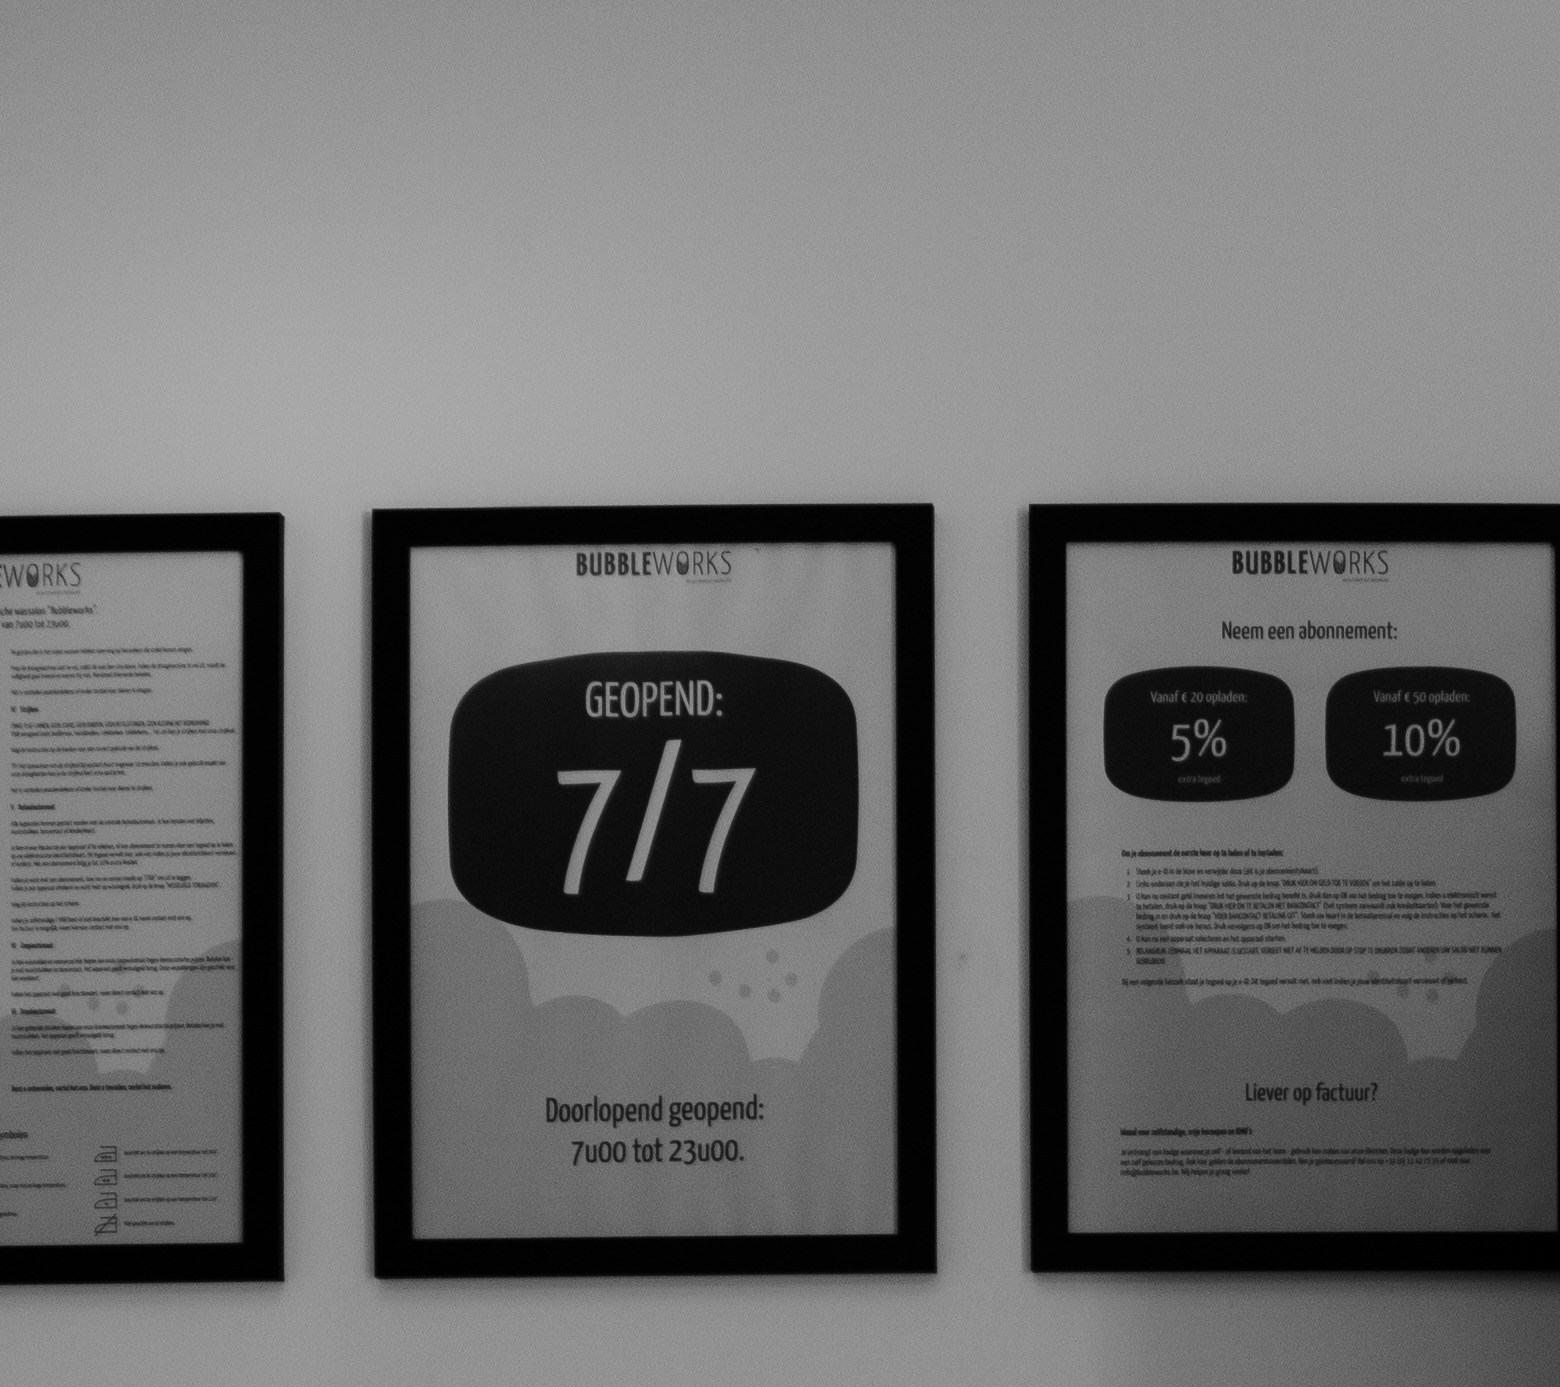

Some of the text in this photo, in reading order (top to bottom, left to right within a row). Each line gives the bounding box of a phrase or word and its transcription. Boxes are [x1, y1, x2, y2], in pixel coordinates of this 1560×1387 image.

[575, 550, 732, 577] BUBBLEWORKS
[1232, 550, 1389, 575] BUBBLEWORKS
[1222, 621, 1398, 640] Neem een abonnement:
[584, 680, 724, 718] GEOPEND:
[1150, 690, 1248, 705] Vanaf € 20 opladen:
[1374, 690, 1470, 705] Vanaf € 50 opladen:
[1170, 718, 1227, 762] 5%
[1383, 718, 1460, 757] 10%
[1178, 774, 1196, 784] extra
[1401, 774, 1419, 784] extra
[557, 739, 757, 894] 7/7
[1245, 1082, 1379, 1106] Liever op factuur?
[545, 1095, 765, 1127] Doorlopend geopend:
[571, 1137, 744, 1165] 7u00 tot 23u00.
